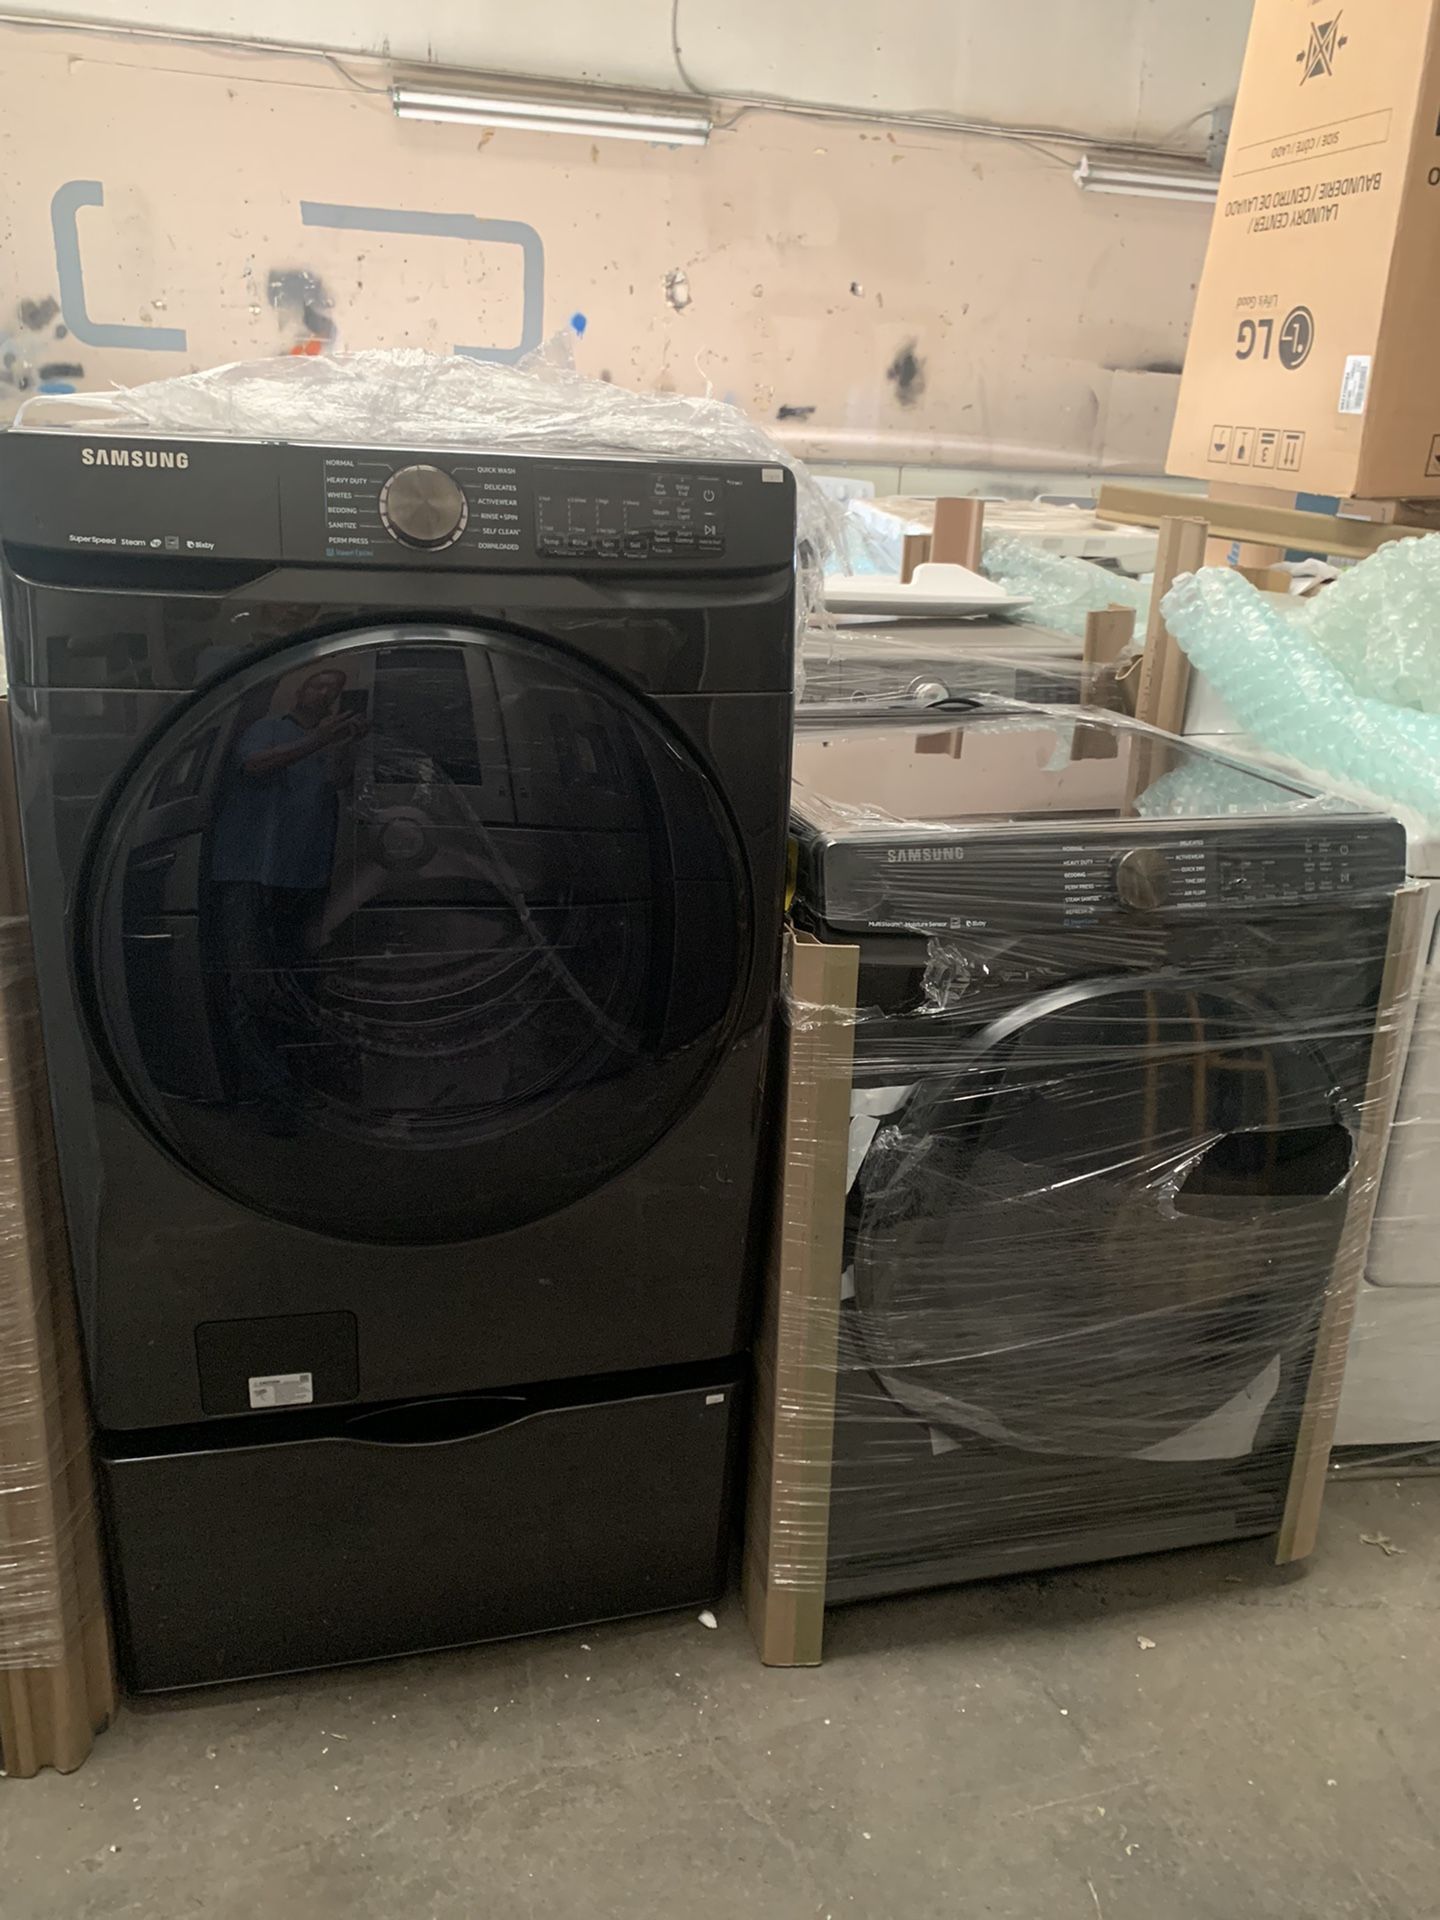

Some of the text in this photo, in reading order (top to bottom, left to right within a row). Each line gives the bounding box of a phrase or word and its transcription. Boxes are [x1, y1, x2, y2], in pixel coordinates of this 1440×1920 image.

[1321, 131, 1340, 145] SIDE
[1318, 172, 1382, 200] BAUNDERIE
[1259, 194, 1272, 211] DE
[1273, 186, 1311, 209] CENTRO
[1224, 196, 1259, 217] LAVADO
[1289, 203, 1339, 228] LAUNDRY
[1253, 212, 1290, 233] CENTER
[1235, 318, 1274, 361] LG
[82, 448, 189, 469] SAMSUNG
[326, 460, 355, 468] NORMAL
[477, 466, 497, 474] QUICK
[326, 476, 368, 485] HEAVY DUTY
[484, 483, 517, 491] DELICATES
[477, 498, 518, 506] ACTIVEWEAR
[504, 513, 518, 521] SPIN
[120, 537, 147, 547] Steam
[194, 540, 216, 551] Bixby
[328, 536, 369, 545] PERM PRESS
[478, 542, 520, 550] DOWNLOADED
[887, 847, 964, 863] SAMSUNG
[1064, 871, 1087, 879] BEDDING
[928, 920, 948, 928] Sensor
